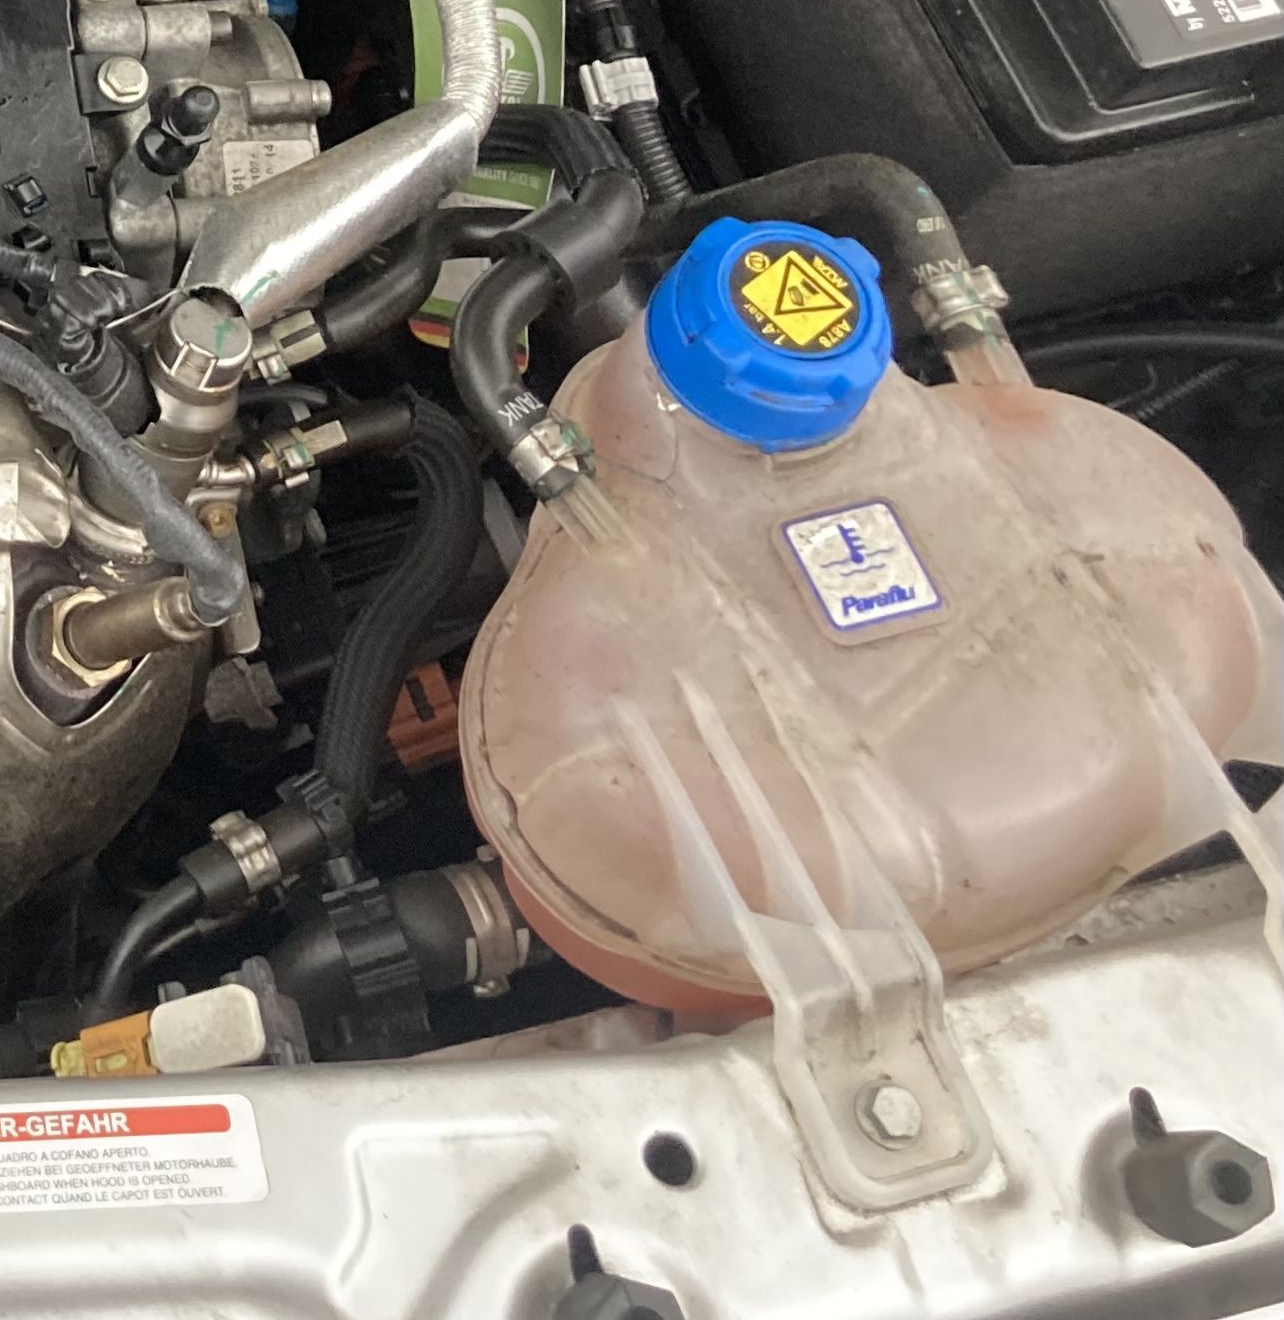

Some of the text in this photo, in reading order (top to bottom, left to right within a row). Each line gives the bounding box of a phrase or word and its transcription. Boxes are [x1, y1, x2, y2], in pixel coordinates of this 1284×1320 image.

[1183, 16, 1204, 31] by
[497, 391, 543, 426] TANK
[841, 585, 916, 617] Paraflu
[40, 1150, 49, 1161] A
[52, 1148, 99, 1161] COFANO
[102, 1146, 150, 1160] APERTO.
[45, 1164, 63, 1176] BEI
[66, 1160, 151, 1176] GEOEFFNETER
[53, 1177, 88, 1190] WHEN
[91, 1175, 126, 1188] HOOD
[129, 1174, 139, 1186] IS
[51, 1189, 92, 1204] QUAND
[95, 1189, 109, 1202] LE
[111, 1187, 151, 1201] CAPOT
[153, 1186, 175, 1199] EST
